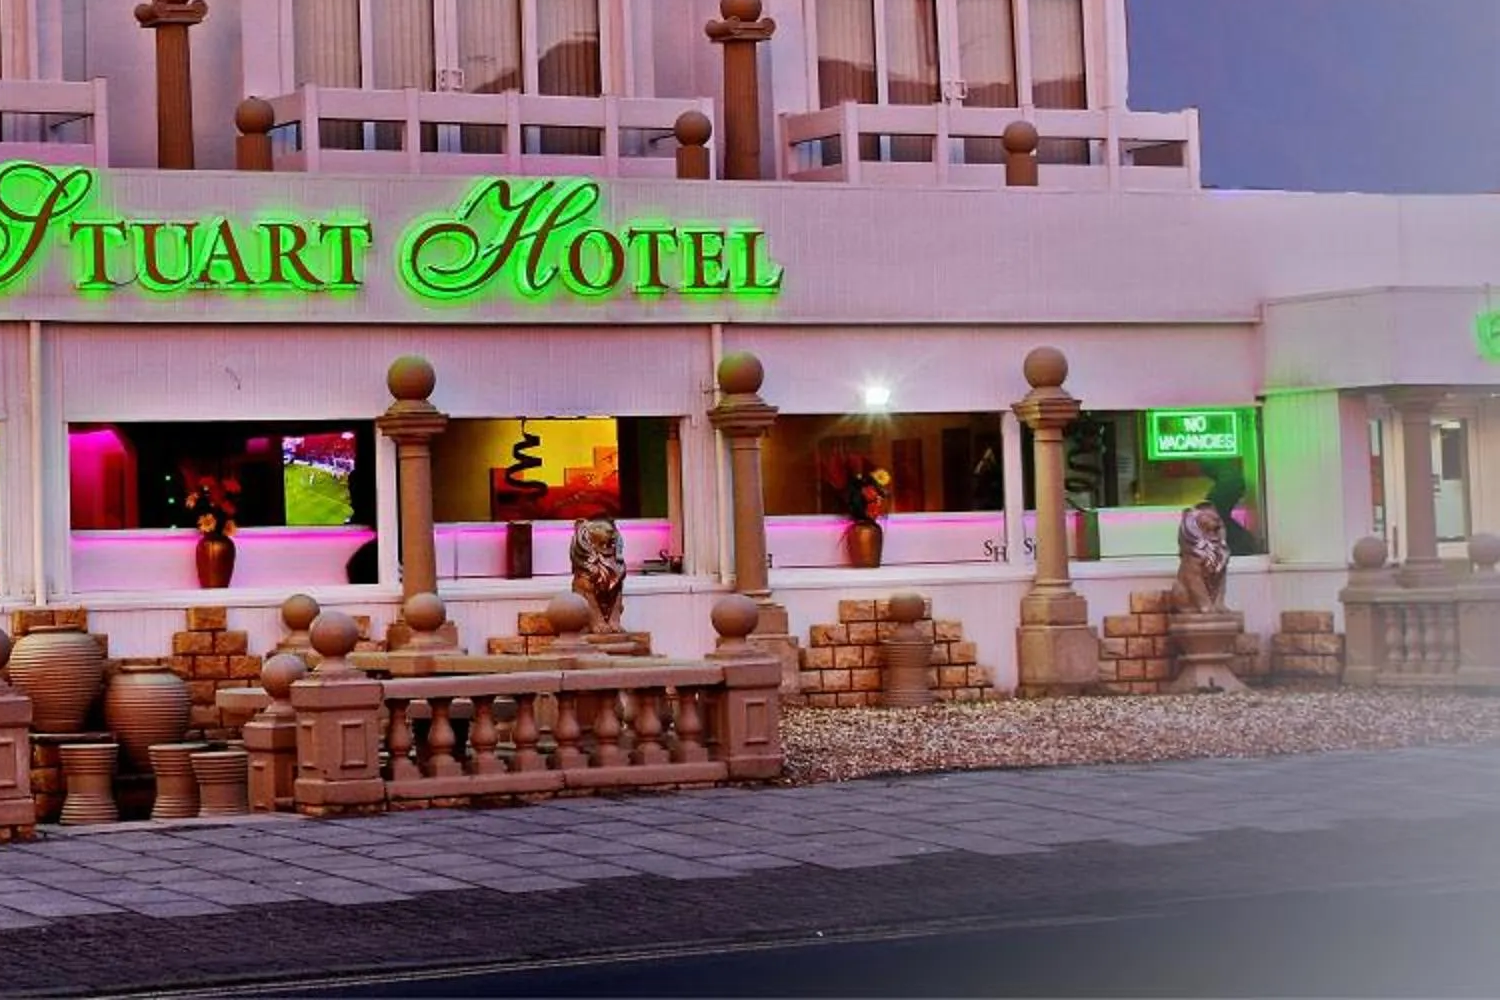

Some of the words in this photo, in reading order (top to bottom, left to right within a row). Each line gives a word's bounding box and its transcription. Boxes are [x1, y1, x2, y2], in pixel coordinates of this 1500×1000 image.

[408, 178, 784, 297] HOTEL
[1184, 415, 1207, 433] NO
[1159, 433, 1235, 451] VACANCIES
[983, 540, 1007, 562] SH
